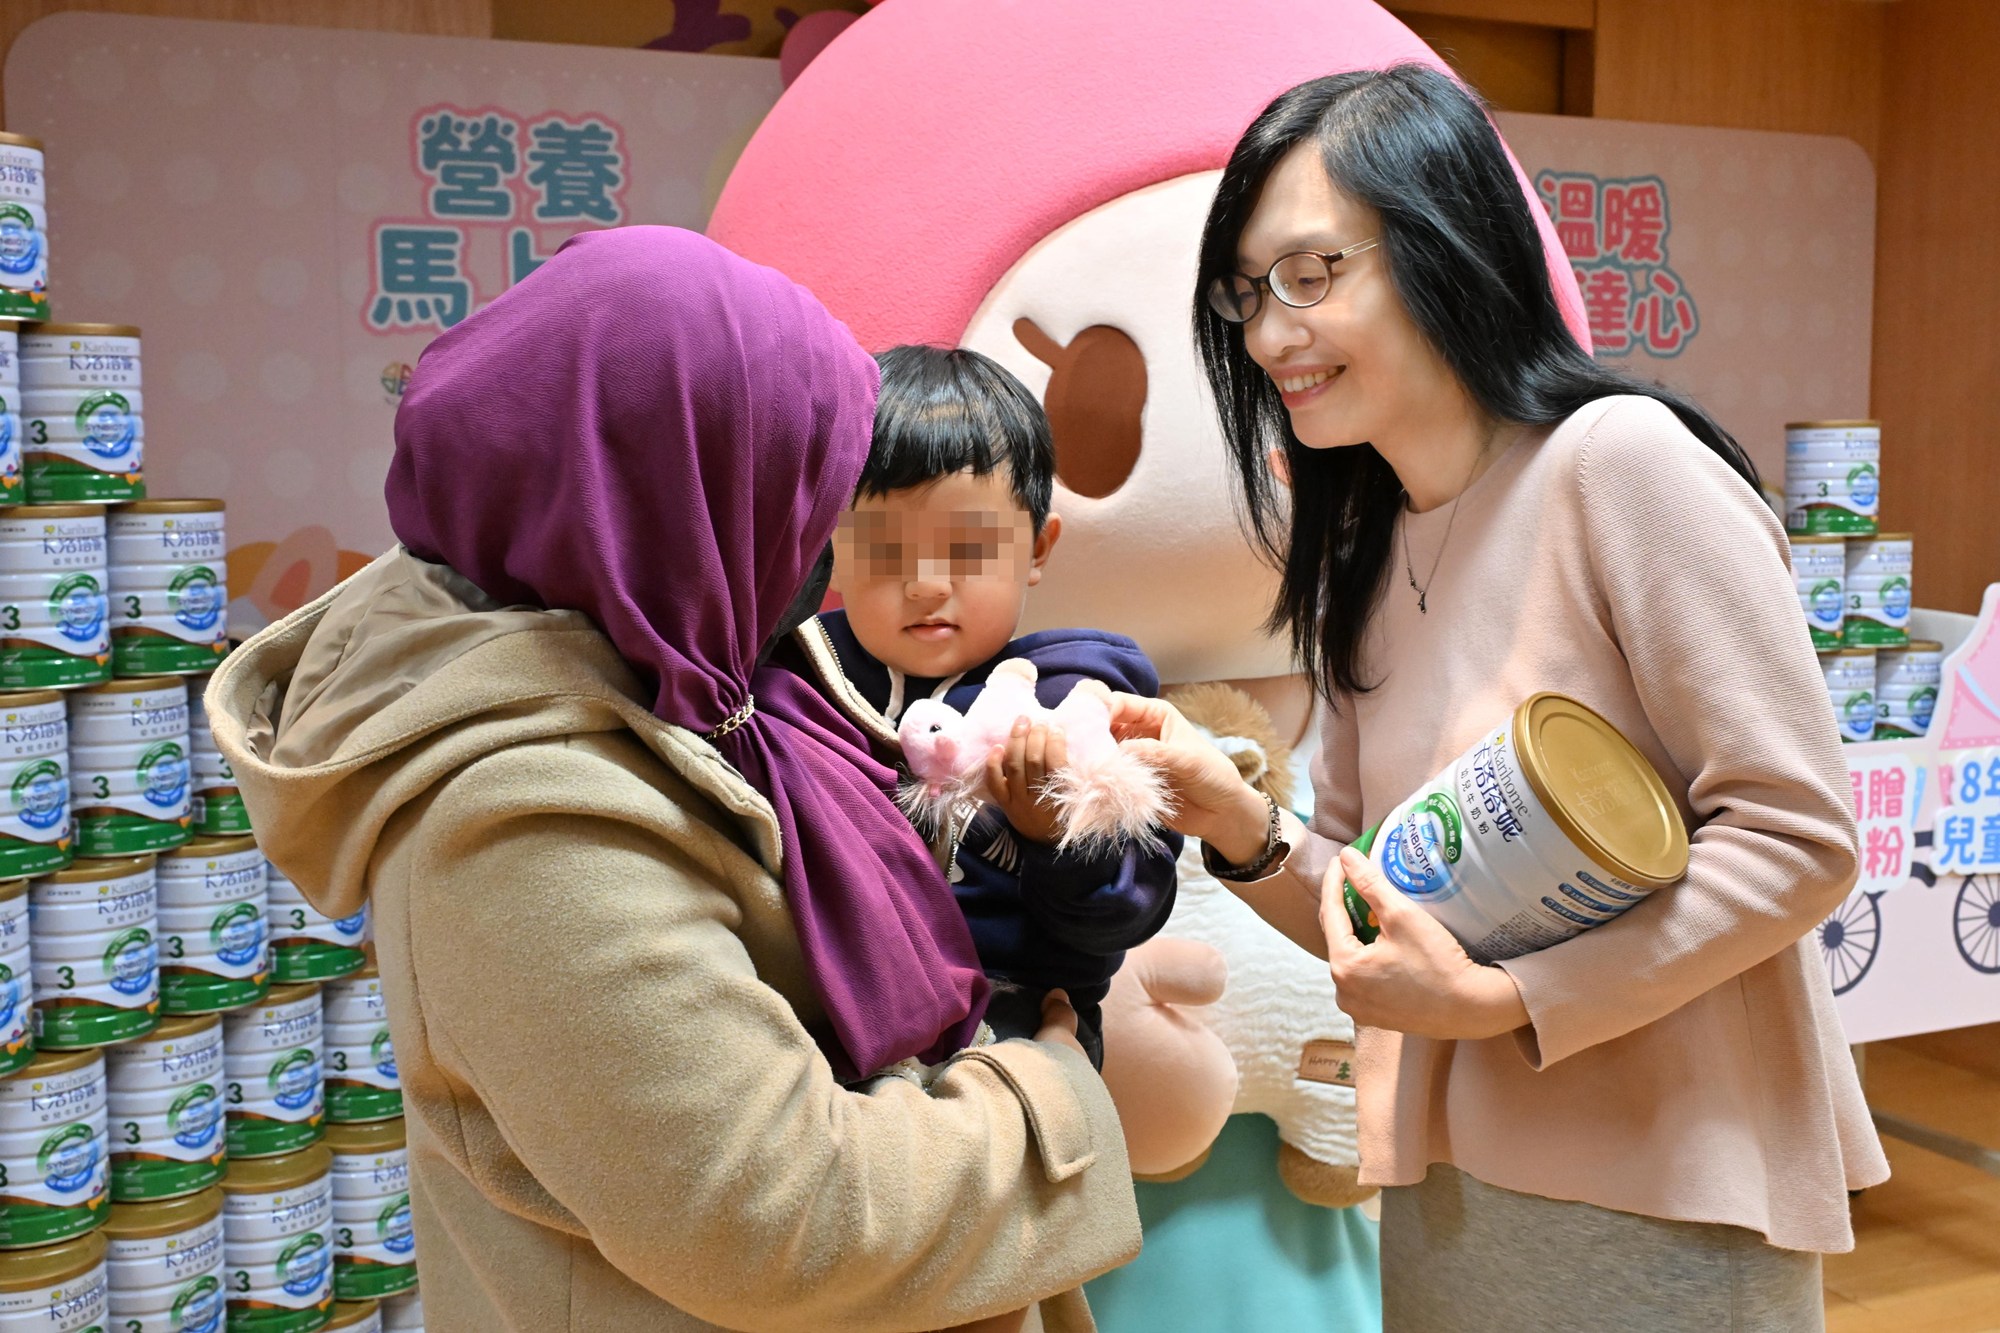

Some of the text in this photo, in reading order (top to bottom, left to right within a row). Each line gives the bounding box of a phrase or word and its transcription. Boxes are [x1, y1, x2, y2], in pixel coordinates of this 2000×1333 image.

[421, 113, 621, 222] 營養
[1541, 178, 1664, 262] 溫暖
[30, 419, 48, 445] 3
[1817, 482, 1828, 497] 3
[124, 595, 142, 619] 3
[1850, 595, 1861, 609] 3
[2, 605, 21, 631] 3
[1879, 704, 1890, 718] 3
[92, 776, 110, 799] 3
[1473, 743, 1524, 843] 卡洛塔妮
[1494, 745, 1528, 817] Karihome
[1461, 768, 1490, 835] 幼兒牛奶粉
[1407, 813, 1435, 879] SYNBIOTIC
[1859, 826, 1904, 879] 粉
[289, 909, 306, 930] 3
[167, 936, 184, 959] 3
[57, 966, 75, 990] 3
[333, 1051, 348, 1072] 3
[227, 1082, 243, 1104] 3
[123, 1121, 141, 1145] 3
[338, 1227, 354, 1249] 3
[234, 1270, 251, 1293] 3
